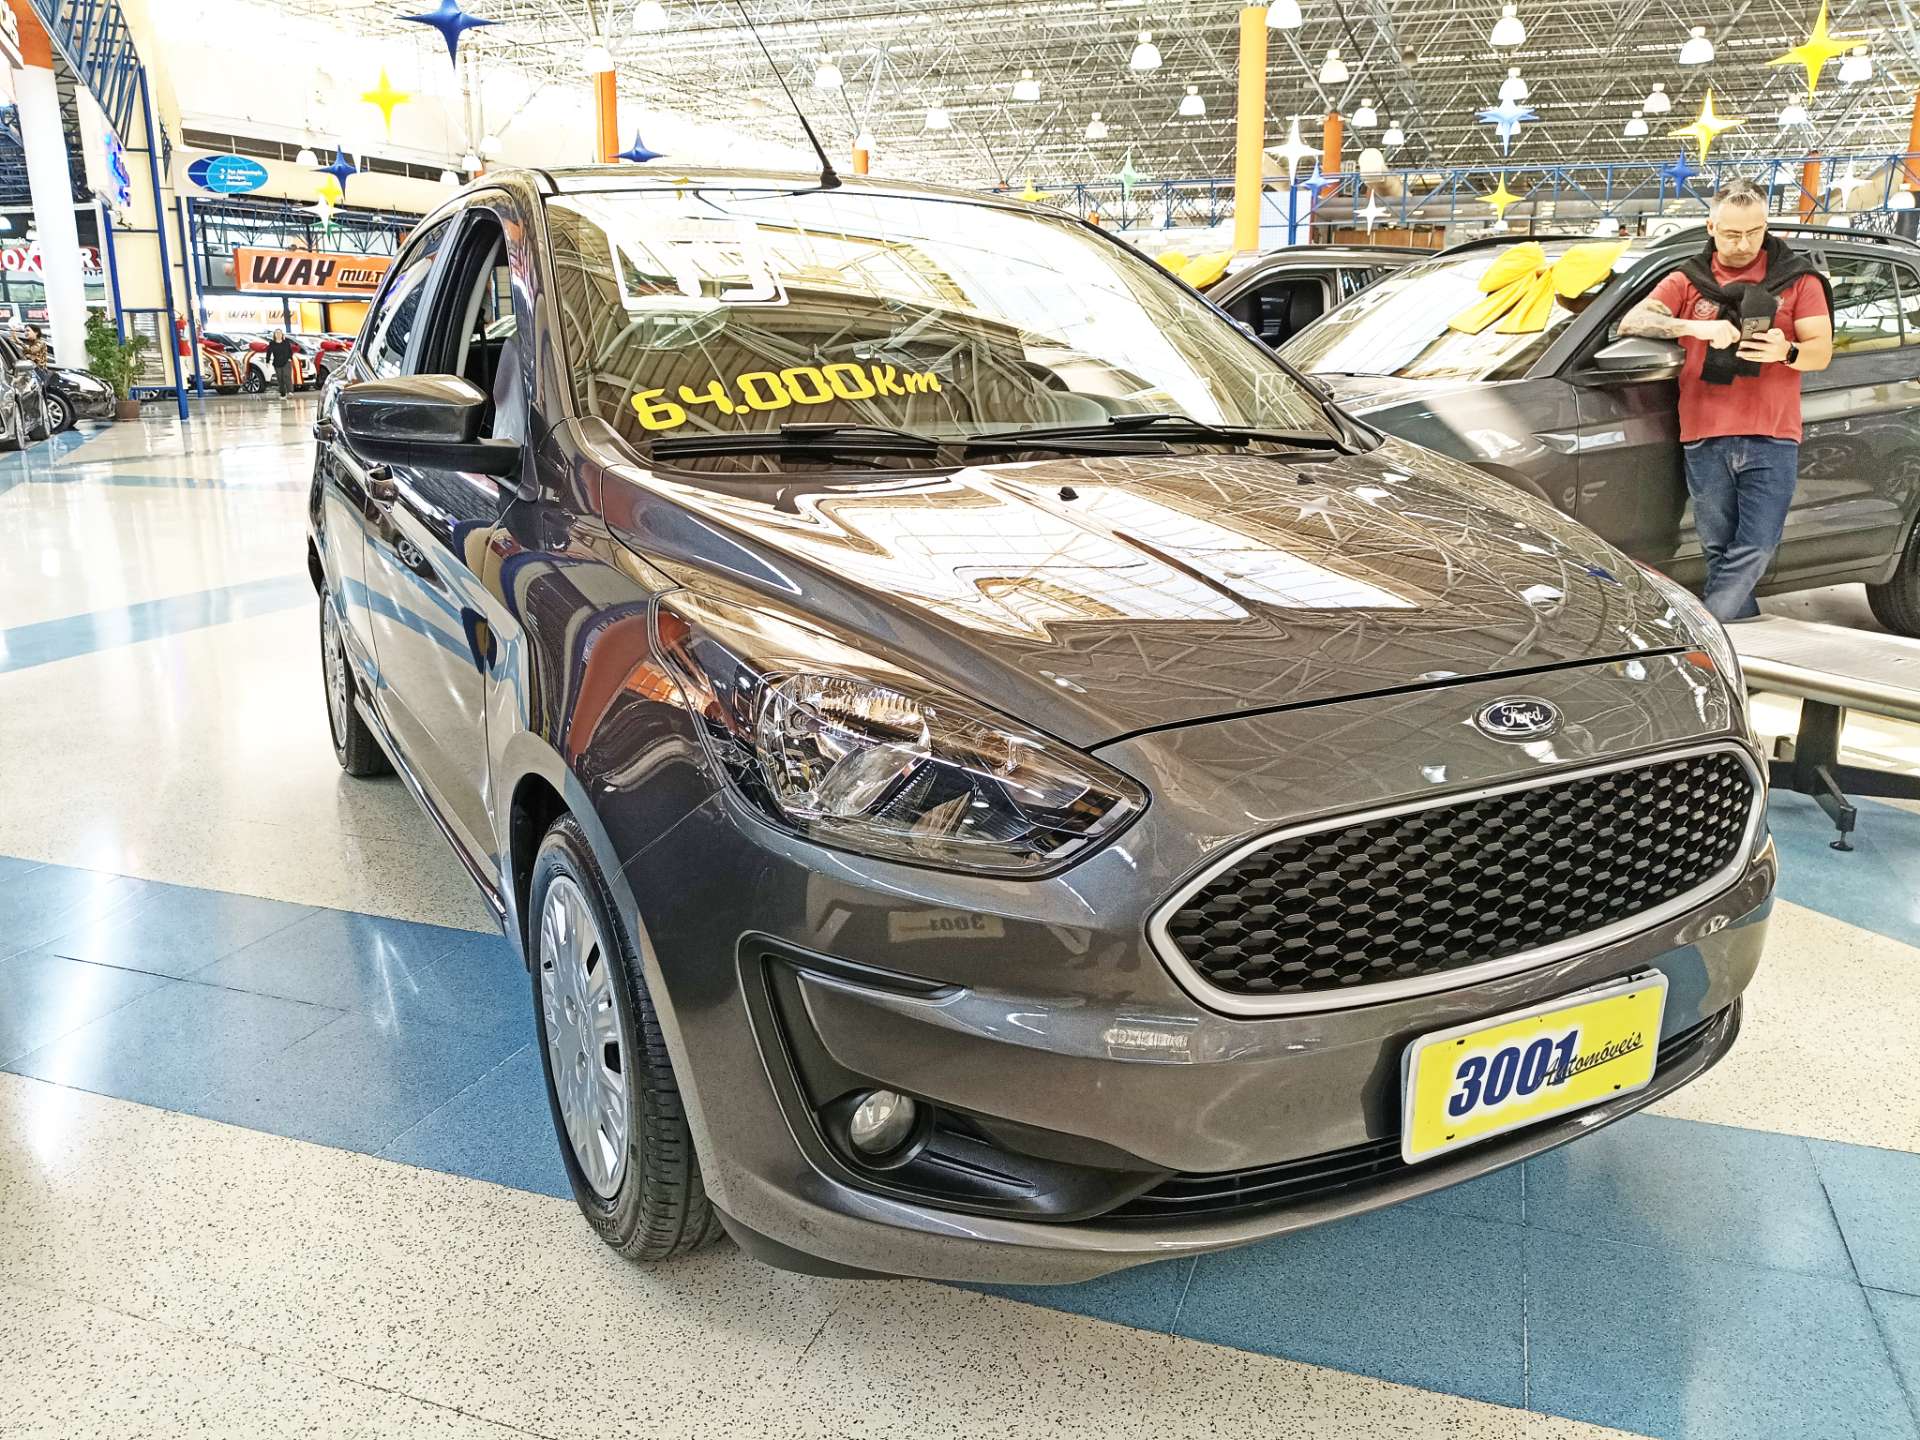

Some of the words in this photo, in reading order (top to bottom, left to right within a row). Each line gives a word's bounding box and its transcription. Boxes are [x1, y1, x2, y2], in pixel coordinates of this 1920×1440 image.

[252, 256, 336, 286] WAY
[339, 269, 385, 283] MULT
[1500, 703, 1544, 727] Ford
[1448, 1029, 1578, 1117] 3001
[1540, 1031, 1644, 1085] Automóveis
